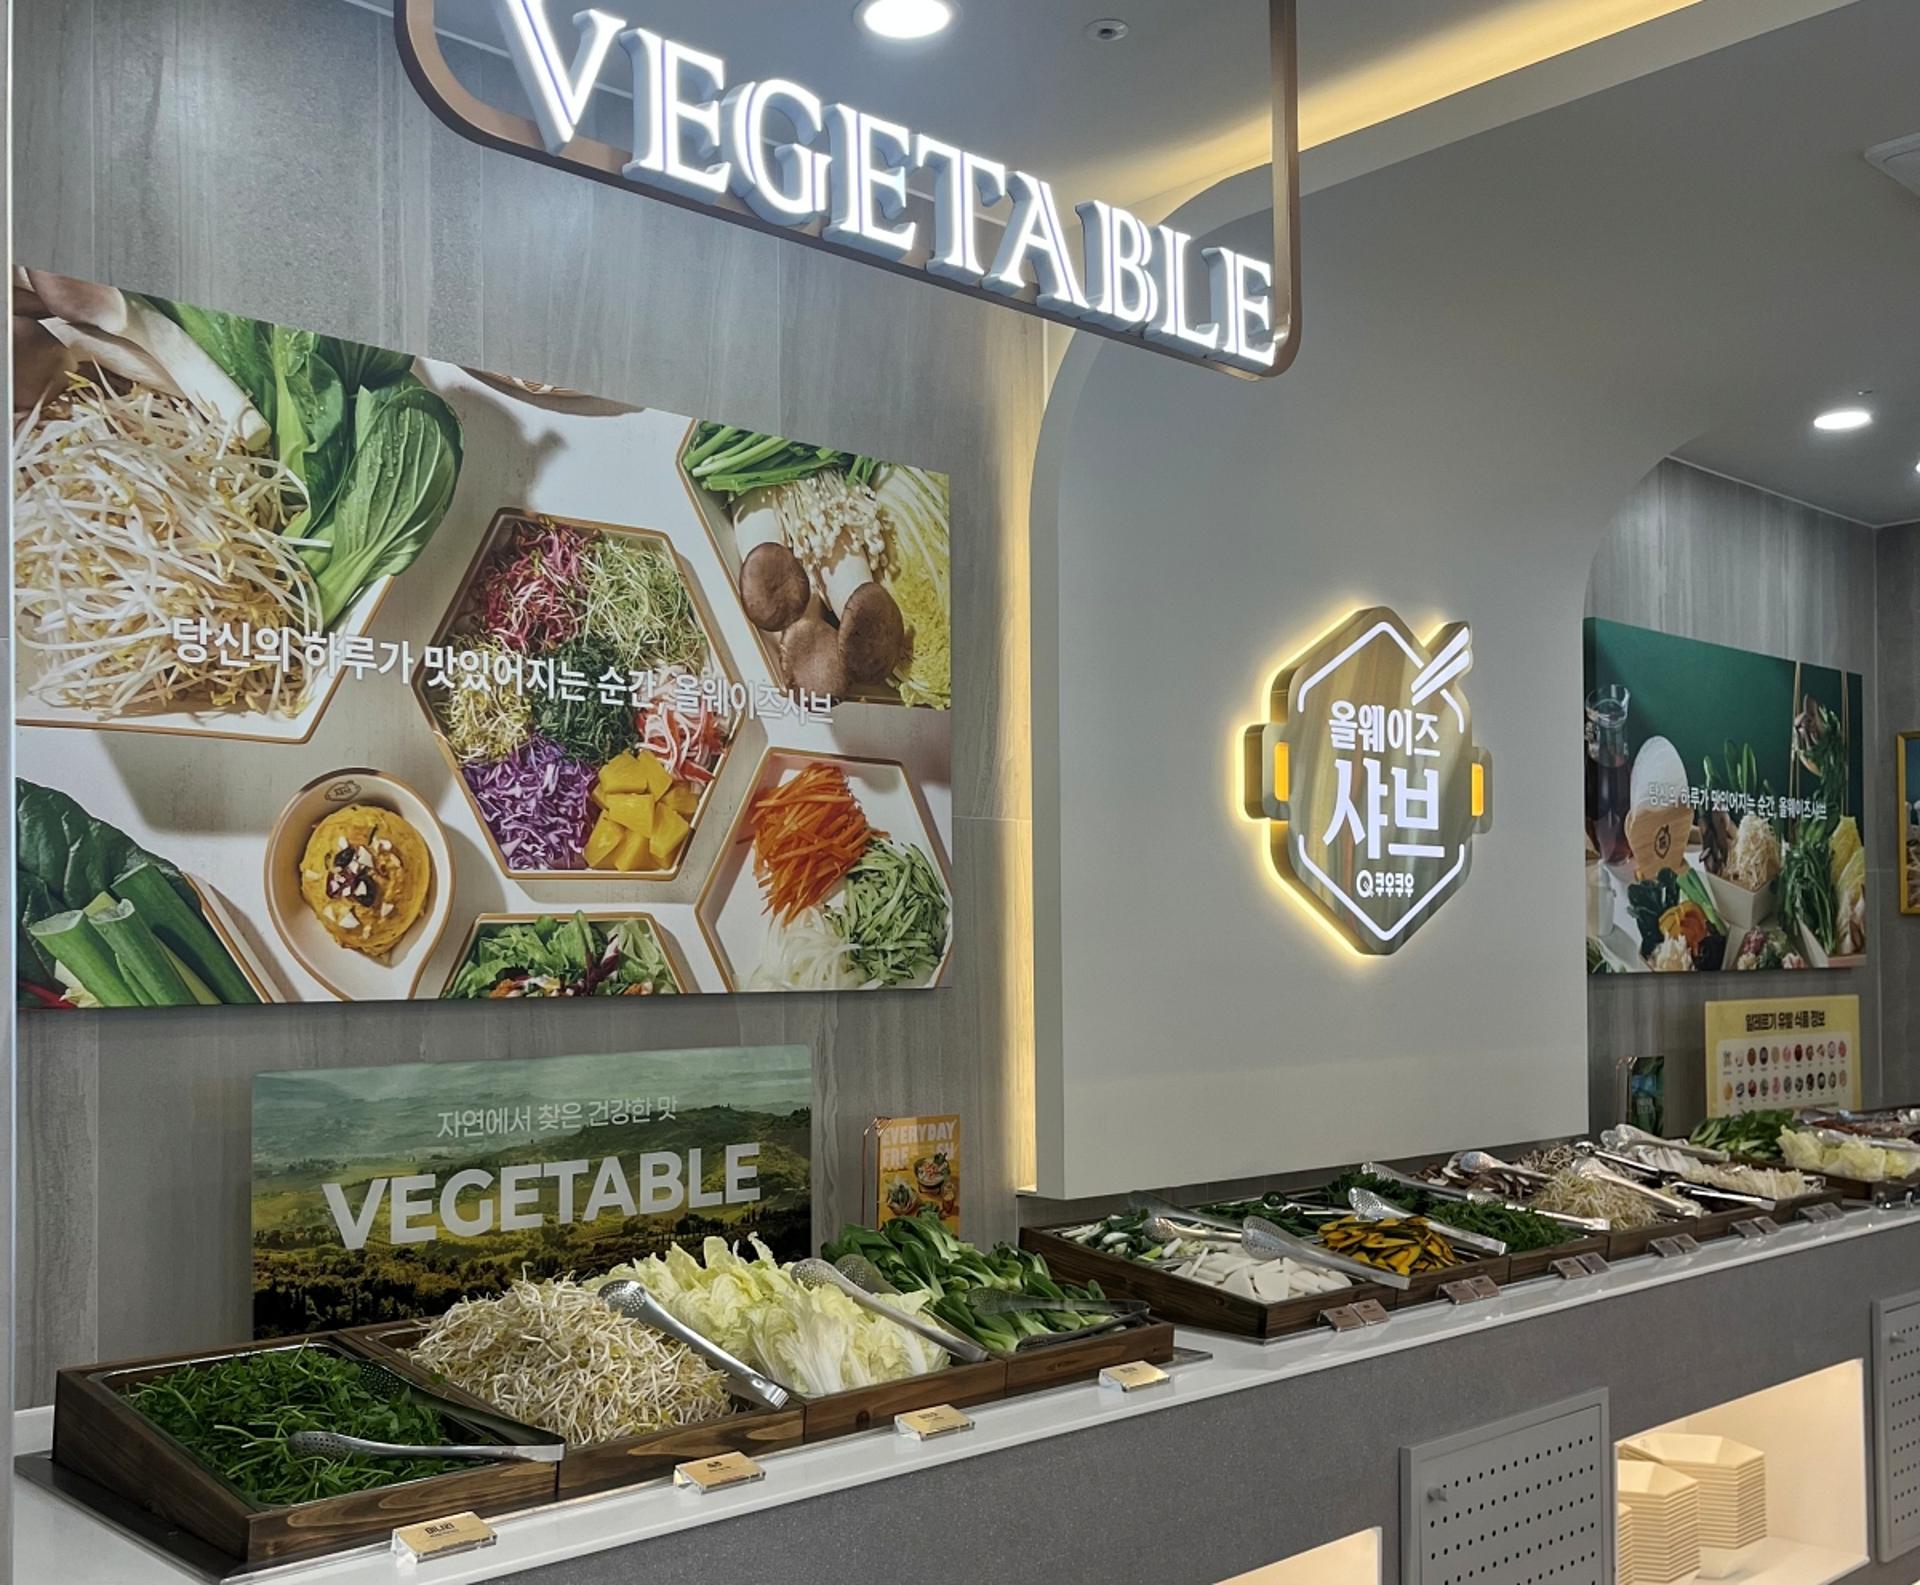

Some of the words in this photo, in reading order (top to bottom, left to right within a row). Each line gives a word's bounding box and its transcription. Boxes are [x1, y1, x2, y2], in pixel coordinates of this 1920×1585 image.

[497, 0, 1277, 367] VEGETABLE
[172, 617, 290, 673] 당신의
[303, 630, 414, 685] 하루가
[424, 645, 589, 702] 맛있어지는
[597, 667, 665, 717] 순간,
[674, 675, 834, 725] 올웨이즈샤브
[1329, 700, 1441, 757] 올웨이즈
[1322, 757, 1445, 860] 샤브
[1649, 782, 1679, 808] 당신의
[1680, 785, 1709, 811] 하루가
[1710, 789, 1756, 816] 맛있어지는
[437, 1105, 531, 1138] 자연에서
[537, 1102, 583, 1131] 찾은
[588, 1097, 652, 1128] 건강한
[657, 1095, 678, 1121] 맛
[880, 1119, 958, 1146] EVERYDAY
[321, 1142, 761, 1252] VEGETABLE
